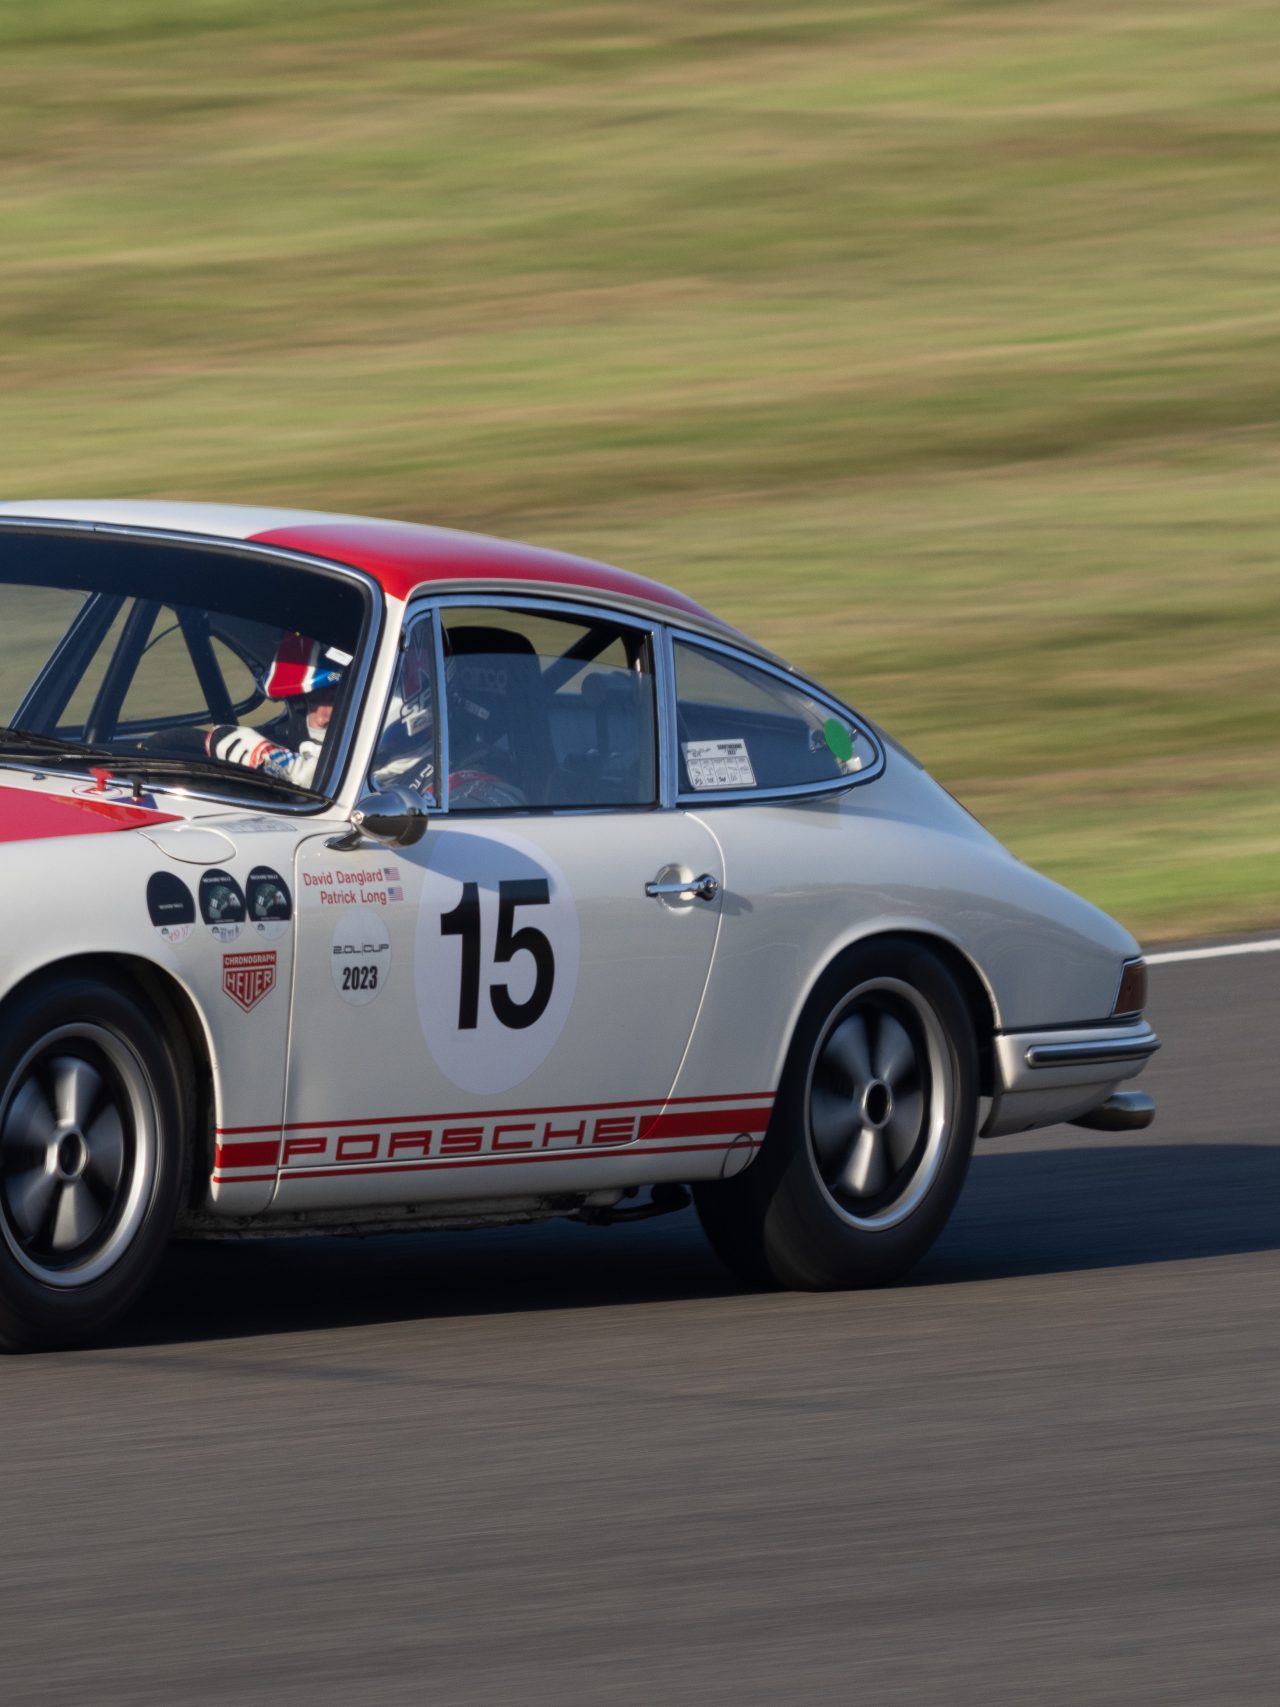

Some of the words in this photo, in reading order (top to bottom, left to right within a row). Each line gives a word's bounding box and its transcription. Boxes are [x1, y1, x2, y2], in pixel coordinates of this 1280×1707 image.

[303, 872, 333, 886] David
[336, 868, 383, 886] Danglard
[320, 889, 356, 904] Patrick
[361, 890, 387, 905] Long
[224, 954, 275, 965] CHRONOGRAPH
[440, 878, 556, 1030] 15
[227, 970, 272, 1004] HEUER
[342, 965, 378, 990] 2023
[282, 1116, 637, 1165] PORSCHE
